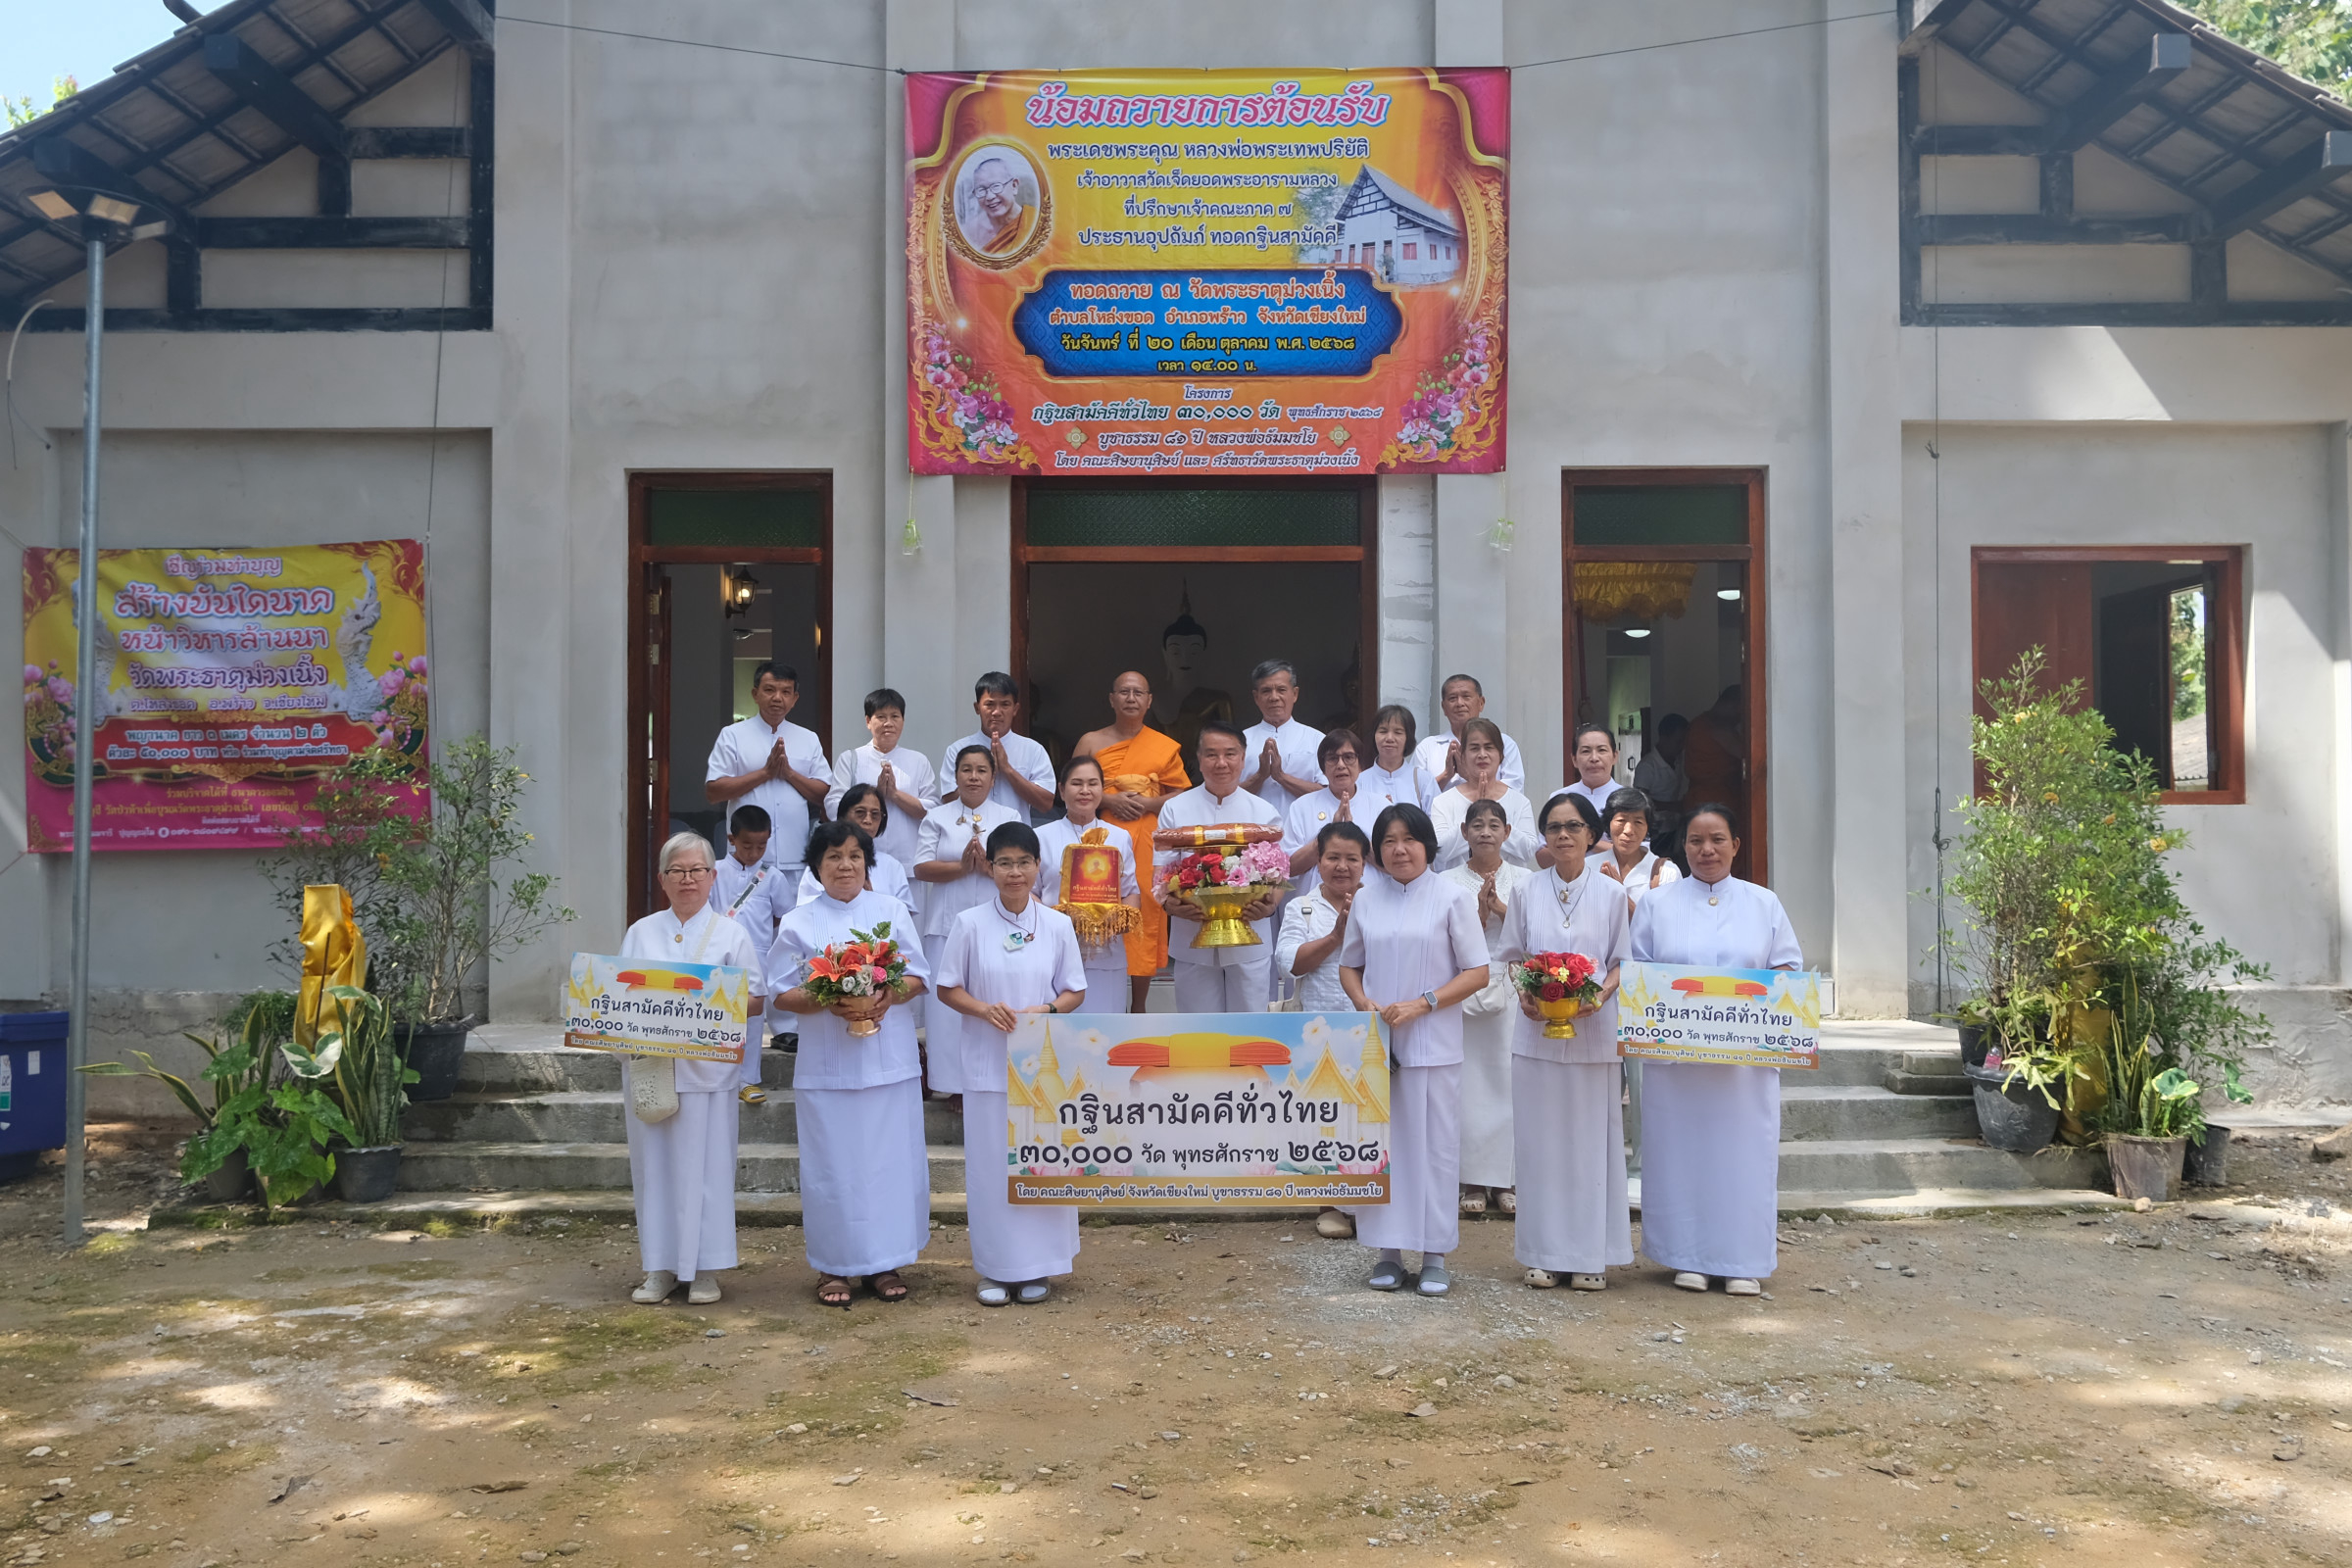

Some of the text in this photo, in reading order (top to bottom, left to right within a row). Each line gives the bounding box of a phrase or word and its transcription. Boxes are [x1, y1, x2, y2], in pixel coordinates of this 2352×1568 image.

[1027, 81, 1391, 127] น้อมถวายการต้อนรับ
[1048, 138, 1369, 165] พระเดชพระคุณ หลวงพ่อพระเทพปริยัติ
[1076, 169, 1338, 189] เจ้าอาวาสวัดเจ็ดยอดพระอารามหลวง
[1123, 194, 1293, 218] ที่ปรึกษาเจ้าคณะภาค ๗
[1078, 223, 1338, 254] ประธานอุปถัมภ์ ทอดกฐินสามัคคี
[1070, 271, 1345, 305] ทอดถวาย ณ วัดพระธาตุม่วงเนิ้ง
[1050, 305, 1367, 325] ตำบลโหล่งขอด อำเภอพร้าว จังหวัดเชียงใหม่
[1060, 327, 1355, 355] วันจันทร์ ที่ ๒๐ เดือน ตุลาคม พ.ศ. ๒๕๖๘
[1157, 359, 1256, 372] เวลา ๑๔.๐๐ น.
[1183, 383, 1233, 401] โครงการ
[1032, 399, 1384, 425] กฐินสามัคคีทั่วไทย ๓๐,๐๐๐ วัด พุทธศักราช ๒๕๖๘
[1098, 428, 1318, 450] บูชาธรรม ๘๑ ปี หลวงพ่อธัมมชโย
[1054, 447, 1360, 471] โดย คณะศิษยานุศิษย์ และ ศรัทธาวัดพระธาตุม่วงเนิ้ง
[167, 556, 282, 578] เชิญร่วมทำบุญ
[116, 580, 334, 618] สร้างบันไดนาค
[120, 622, 330, 654] หน้าวิหารล้านนา
[128, 654, 328, 693] วัดพระธาตุม่วงเนิ้ง
[296, 726, 308, 739] ๒
[193, 746, 219, 759] บาท
[591, 994, 723, 1022] กฐินสามัคคีทั่วไทย
[1644, 1002, 1792, 1027] กฐินสามัคคีทั่วไทย
[571, 1015, 742, 1043] ๓๐,๐๐๐ วัด พุทธศักราช ๒๕๖๘
[1623, 1024, 1814, 1048] ๓๐,๐๐๐ วัด พุทธศักราช ๒๕๖๘
[1059, 1083, 1339, 1134] กฐินสามัคคีทั่วไทย
[1020, 1140, 1379, 1171] ๓๐,๐๐๐ วัด พุทธศักราช ๒๕๖๘
[1016, 1183, 1038, 1198] โดย
[1040, 1182, 1125, 1200] คณะศิษยานุศิษย์
[1128, 1183, 1208, 1198] จังหวัดเชียงใหม่
[1211, 1187, 1262, 1200] บูชาธรรม
[1284, 1183, 1294, 1198] ปี
[1296, 1182, 1383, 1198] หลวงพ่อธัมมชโย
